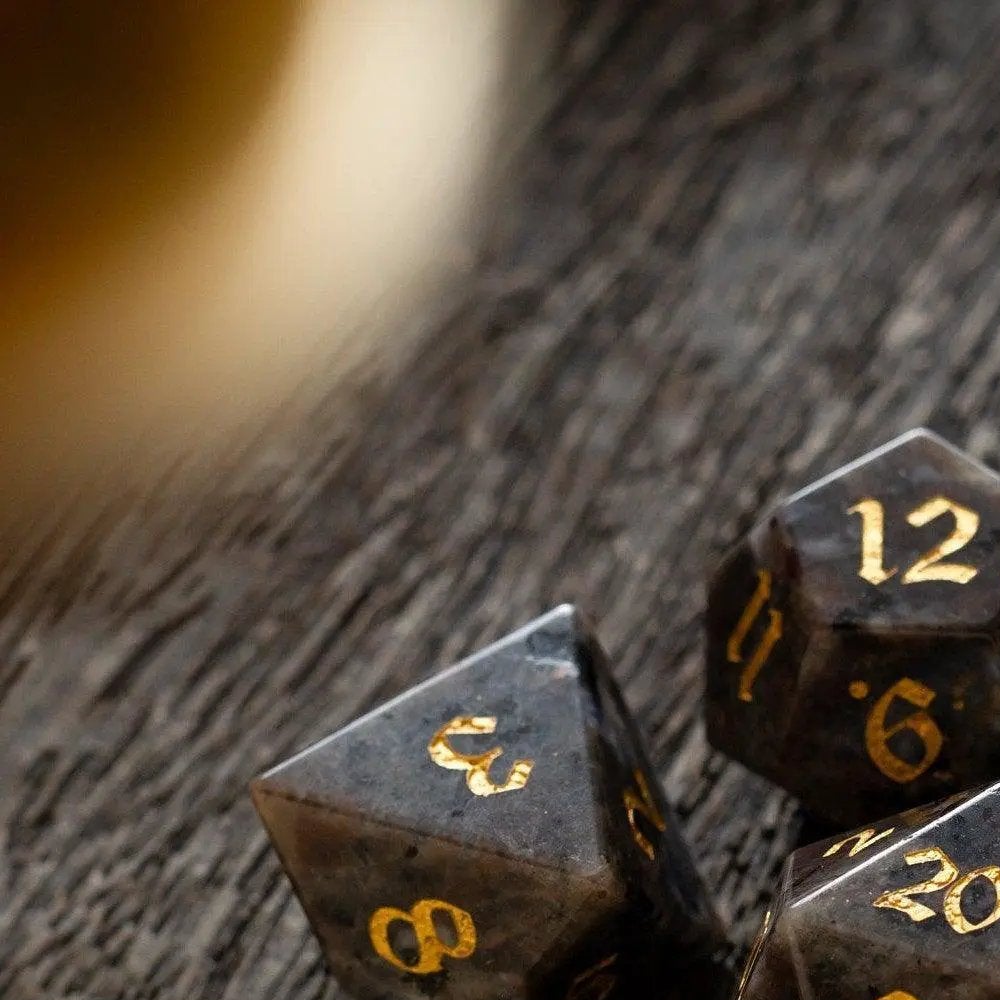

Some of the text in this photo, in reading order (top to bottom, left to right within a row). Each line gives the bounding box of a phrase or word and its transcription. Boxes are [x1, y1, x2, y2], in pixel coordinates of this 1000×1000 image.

[847, 498, 980, 585] 12
[428, 715, 534, 797] 3
[369, 900, 477, 974] 8
